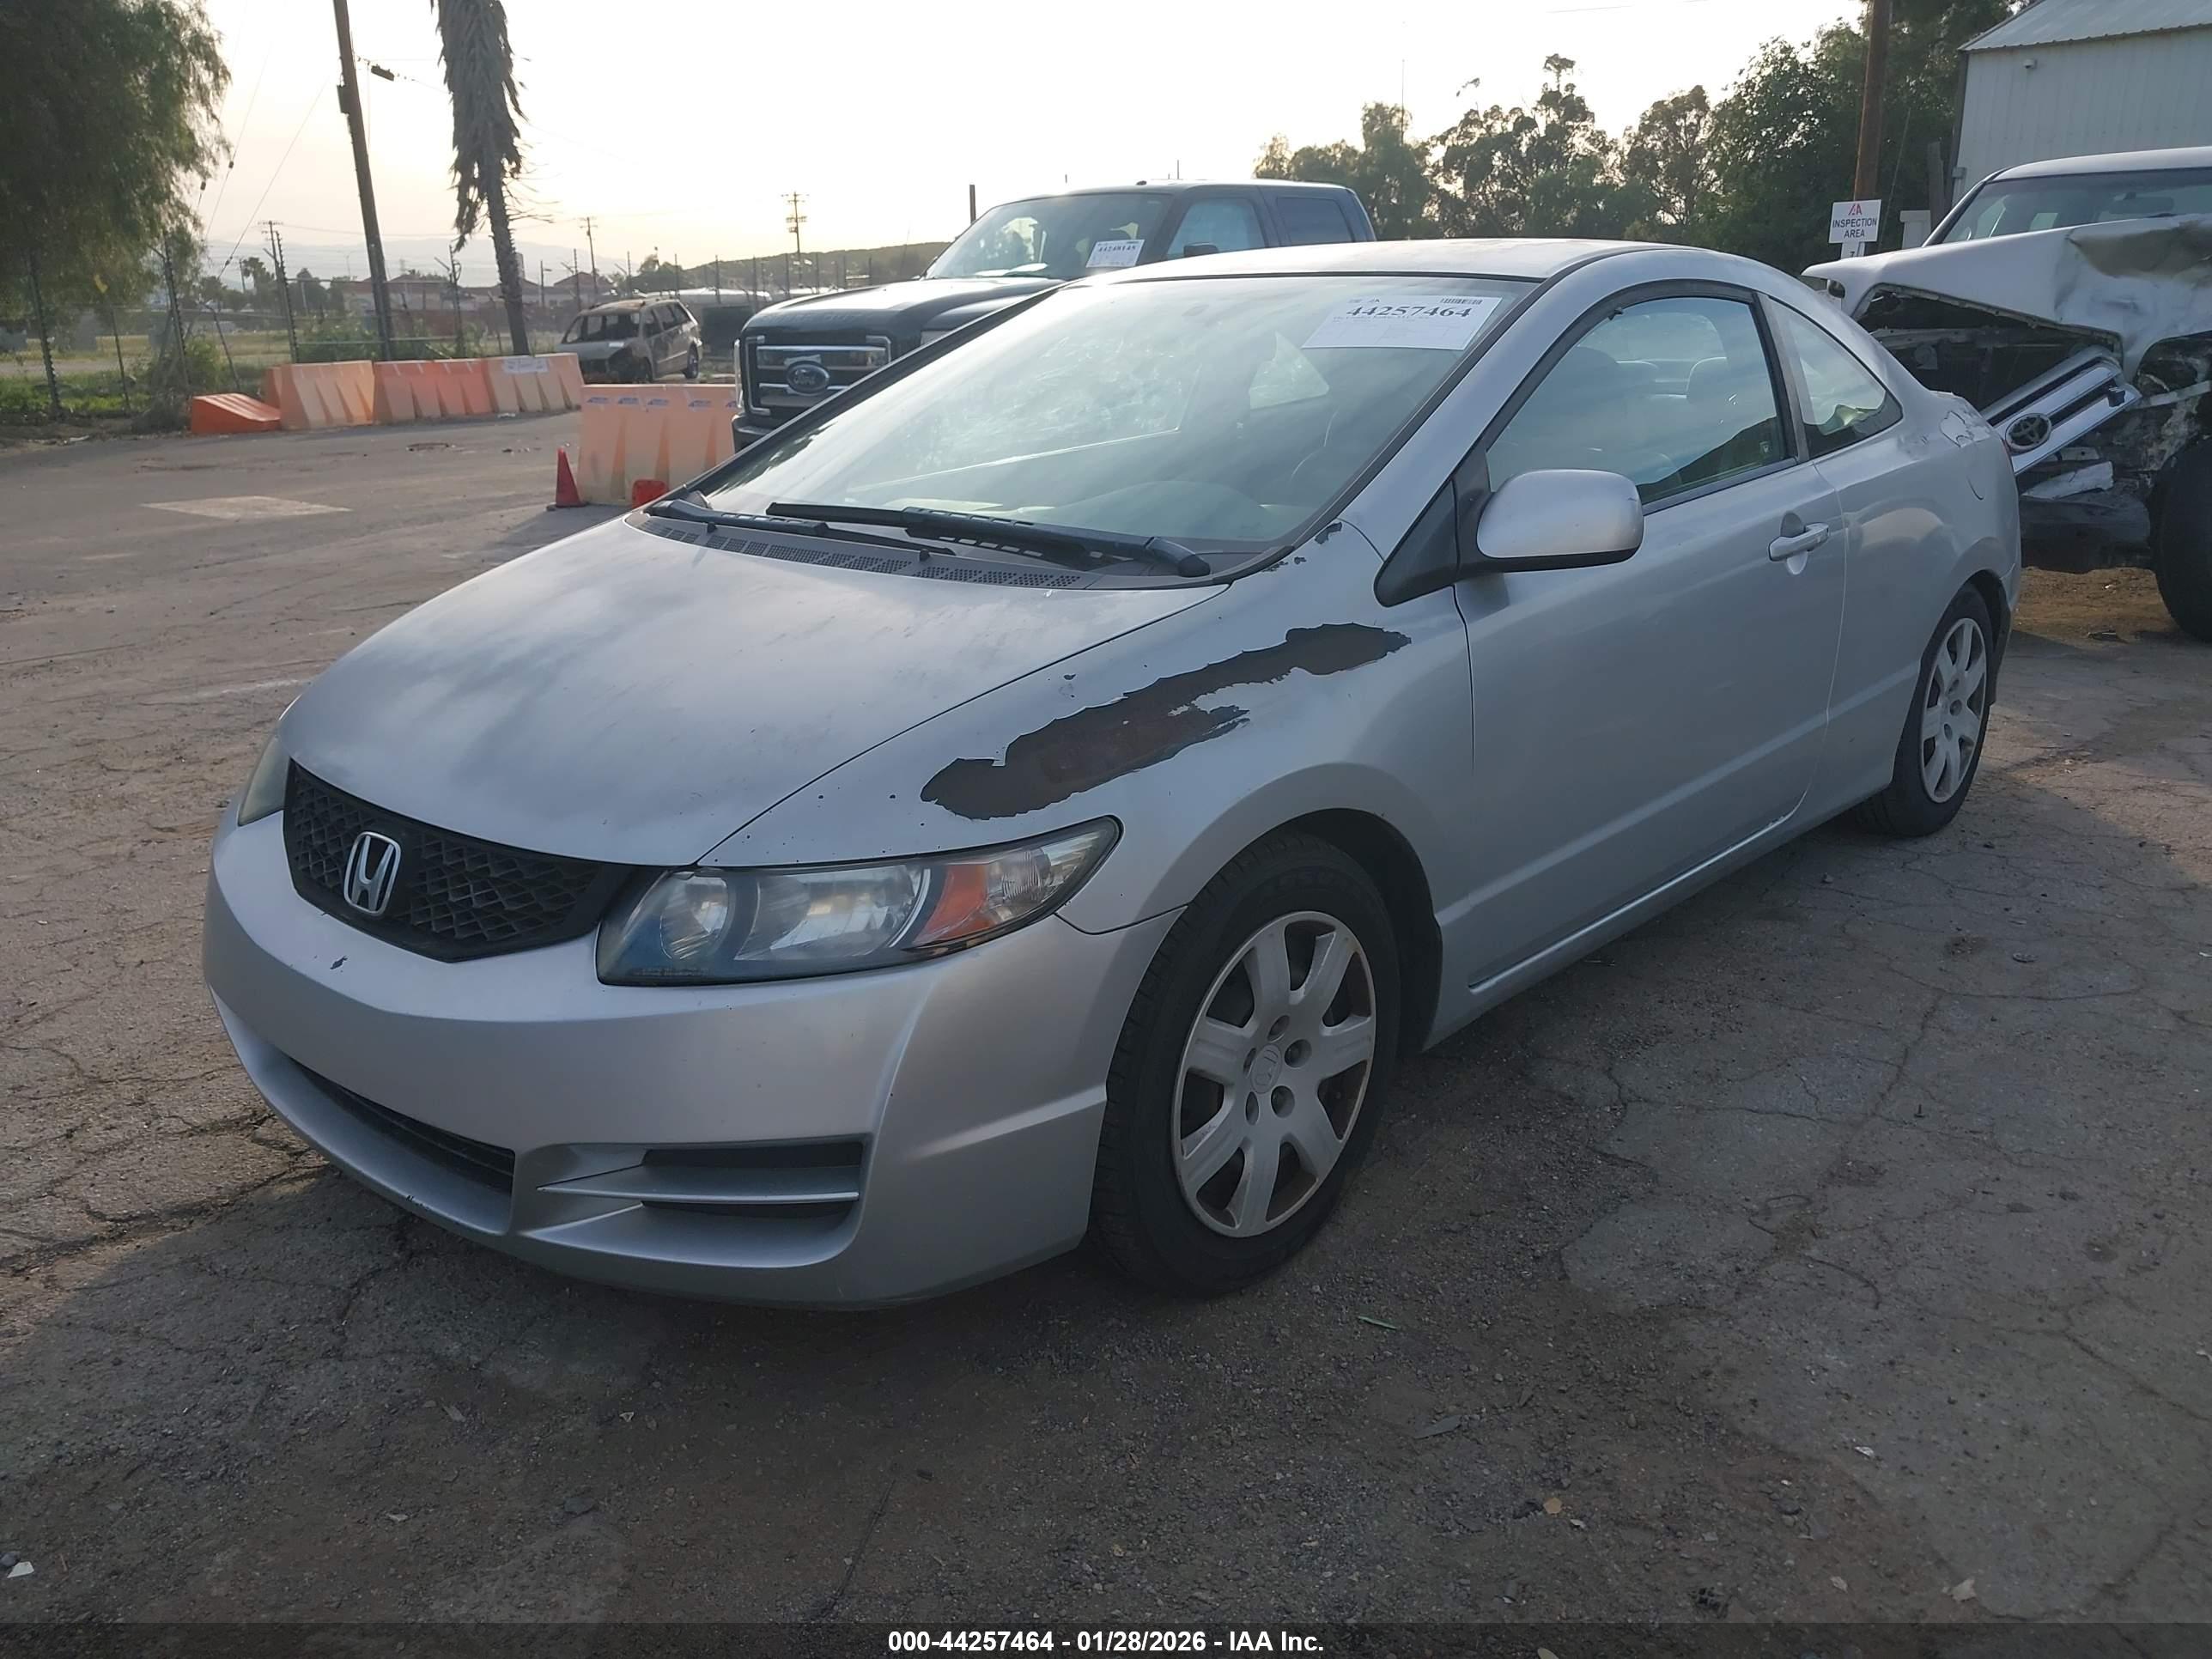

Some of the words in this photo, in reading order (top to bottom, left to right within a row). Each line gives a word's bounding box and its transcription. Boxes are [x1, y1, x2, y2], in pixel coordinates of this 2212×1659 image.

[1832, 217, 1877, 228] INSPECTION
[1844, 229, 1865, 239] AREA
[1346, 306, 1473, 318] 44257464
